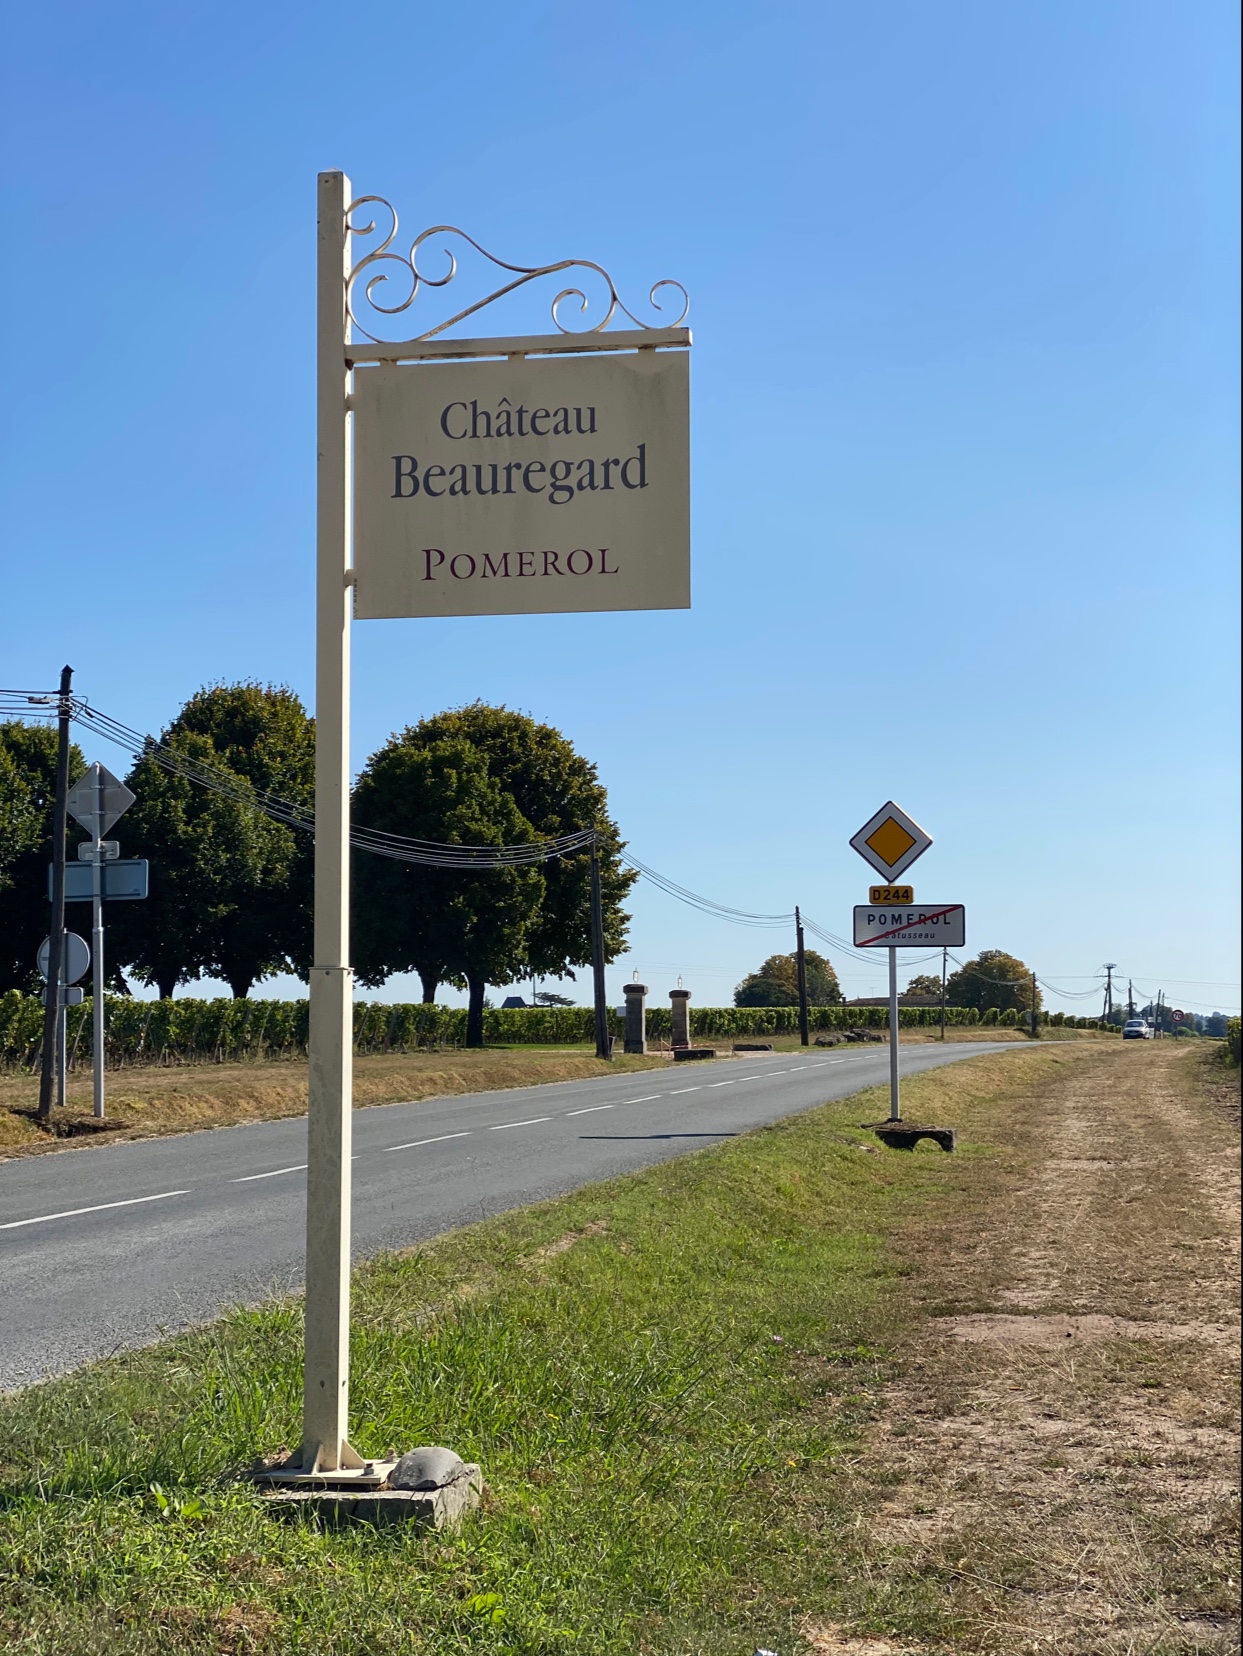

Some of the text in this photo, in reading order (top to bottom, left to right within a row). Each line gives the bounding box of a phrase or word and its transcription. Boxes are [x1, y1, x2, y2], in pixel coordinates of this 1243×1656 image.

[440, 397, 598, 440] Château
[390, 443, 649, 505] Beauregard
[421, 549, 620, 581] POMEROL
[872, 889, 910, 901] D244
[867, 914, 951, 925] POMEROL
